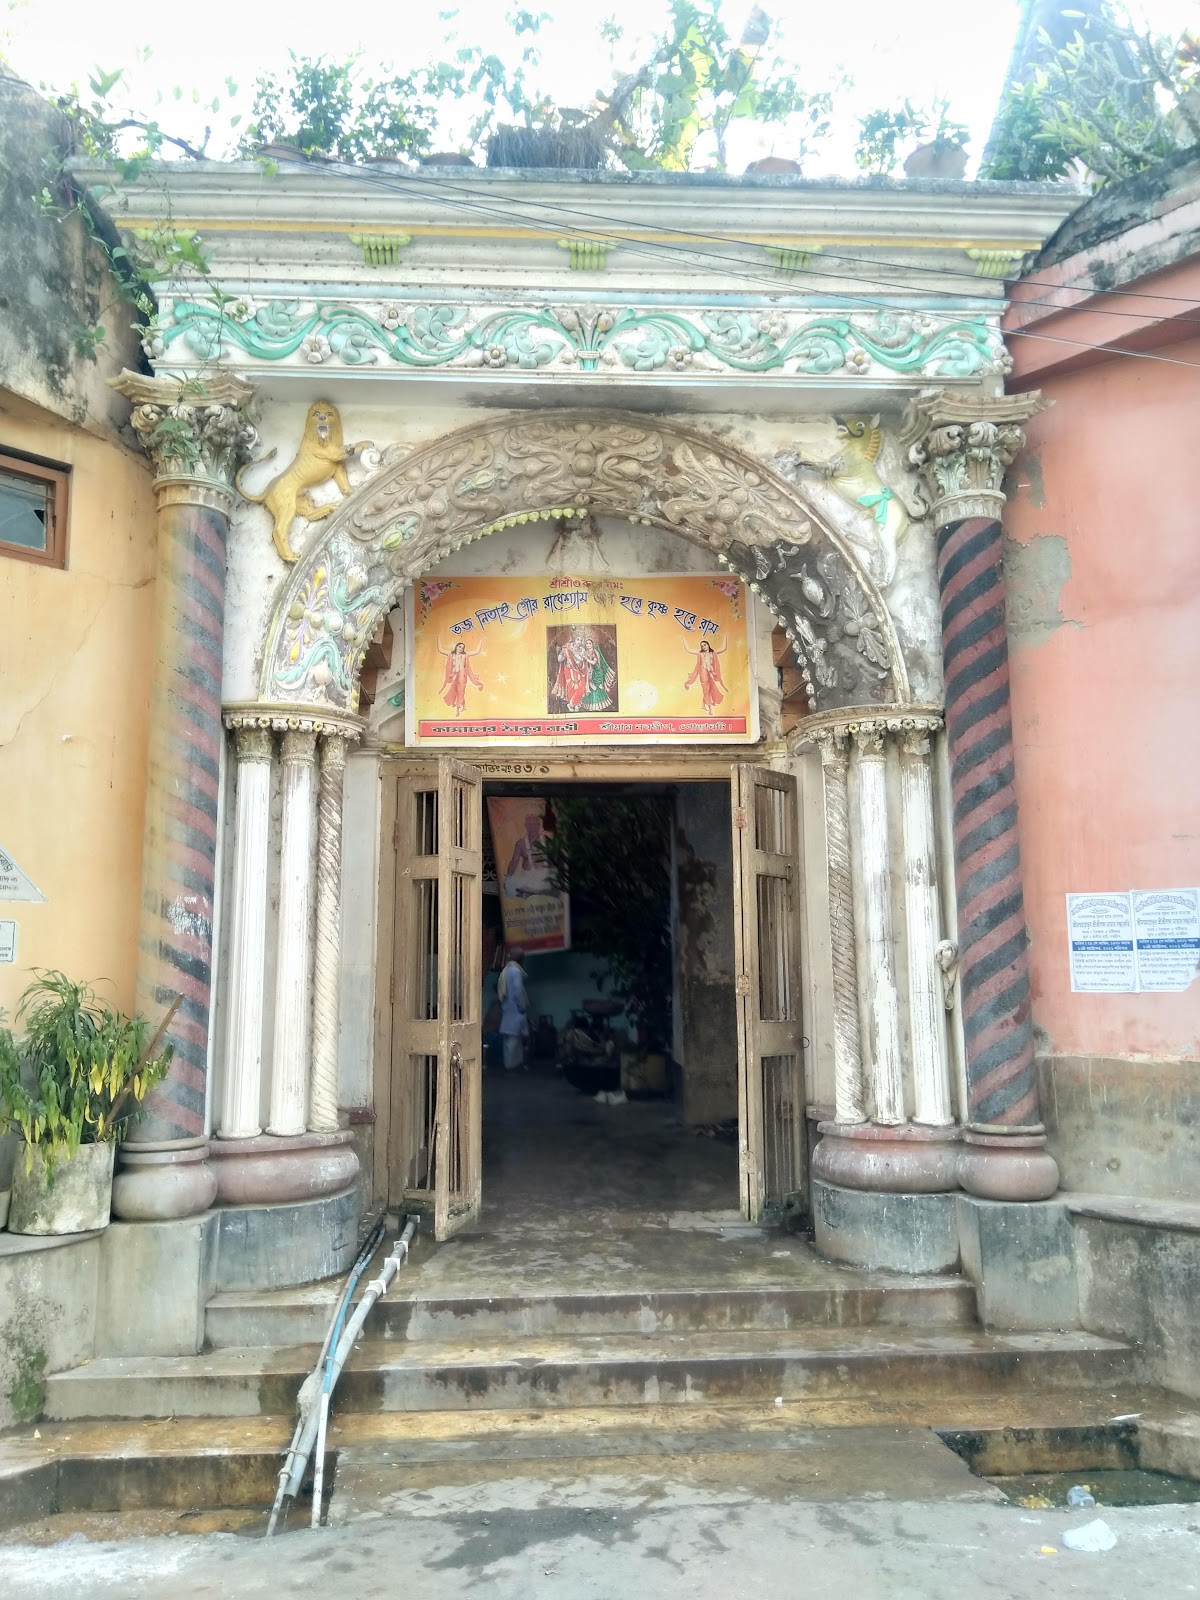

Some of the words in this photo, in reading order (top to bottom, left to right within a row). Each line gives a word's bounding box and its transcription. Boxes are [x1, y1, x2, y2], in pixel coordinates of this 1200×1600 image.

[449, 617, 475, 635] ভজ
[475, 602, 519, 631] নিতাই
[516, 598, 538, 620] গৌর
[542, 590, 589, 613] রাধেশ্যাম
[619, 595, 643, 616] হরে
[647, 600, 669, 619] কৃষ্ণ
[673, 607, 697, 631] হরে
[698, 618, 720, 637] রাম
